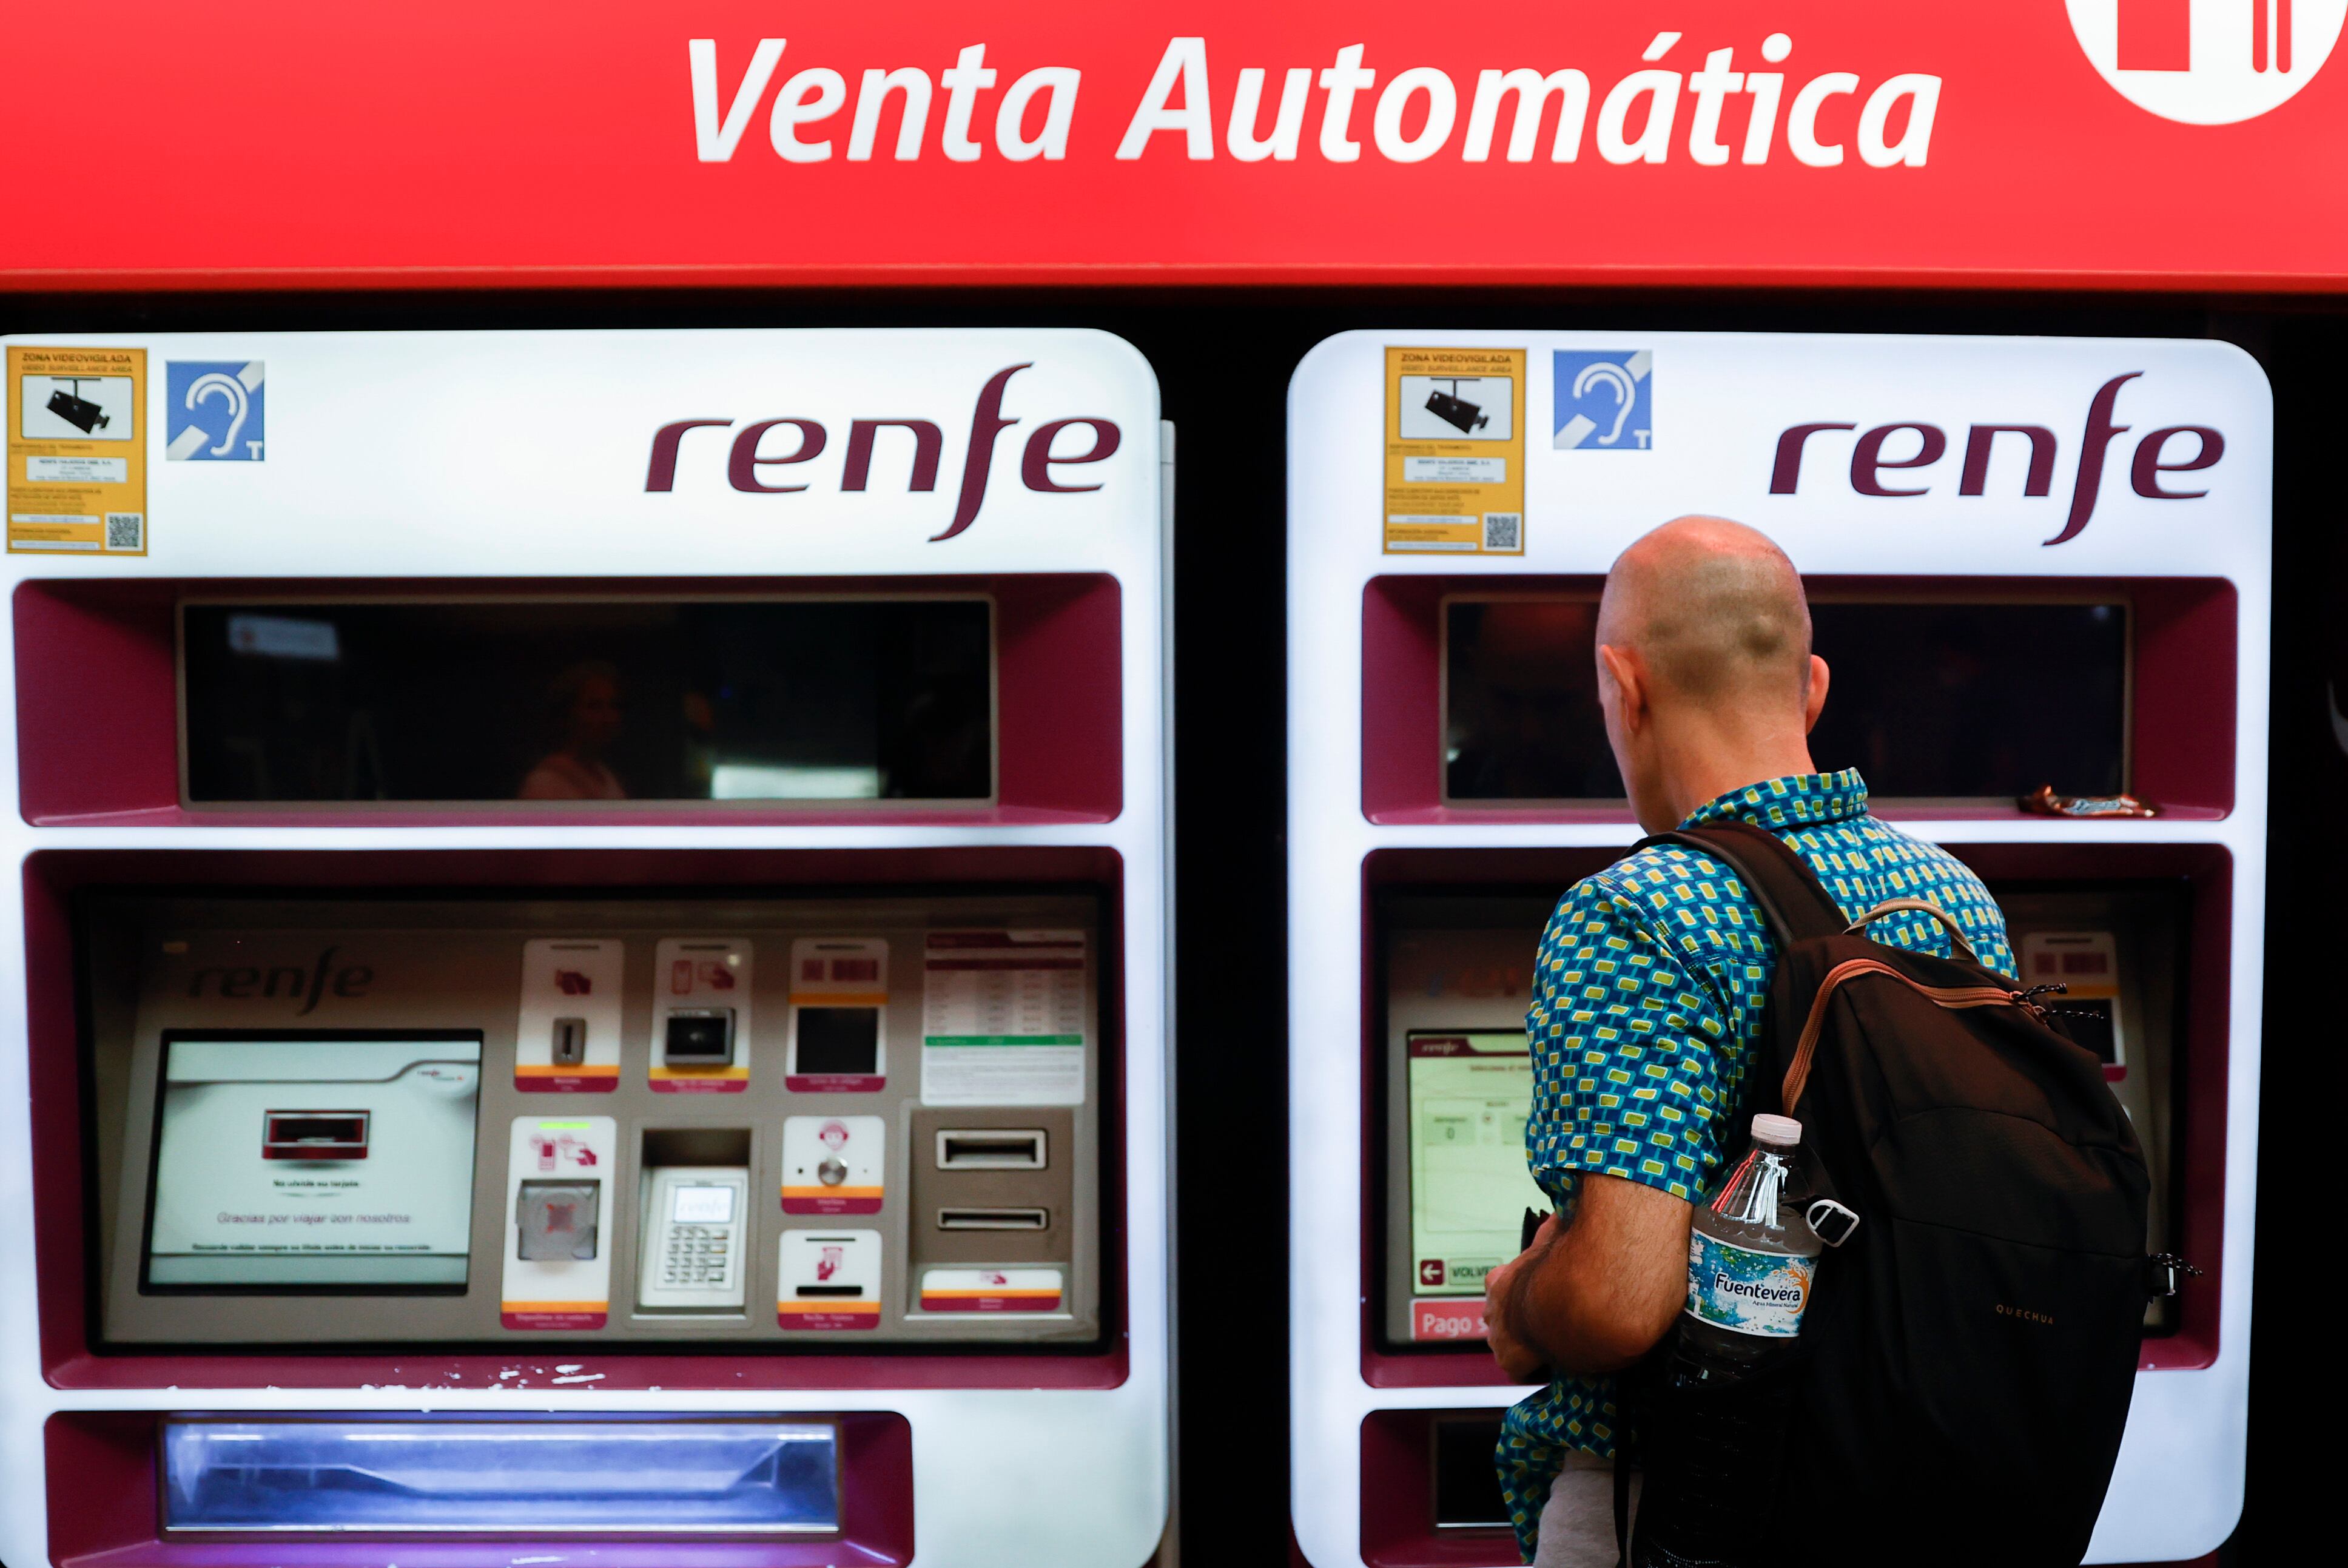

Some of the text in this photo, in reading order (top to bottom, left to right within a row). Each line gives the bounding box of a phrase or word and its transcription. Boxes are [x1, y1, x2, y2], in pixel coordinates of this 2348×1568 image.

[688, 32, 1942, 169] Venta Automática
[22, 352, 132, 363] ZONA VIDEOVIGILADA
[1401, 352, 1512, 363] ZONA VIDEOVIGILADA
[245, 440, 263, 460] T
[1633, 428, 1651, 449] T
[644, 362, 1122, 543] renfe
[1768, 371, 2226, 547] renfe
[187, 944, 374, 1018] renfe
[217, 1212, 265, 1224] Gracias
[267, 1214, 289, 1226] por
[292, 1213, 326, 1225] viajar
[355, 1213, 411, 1224] nosotros
[1715, 1273, 1801, 1302] Fuentevera
[1422, 1313, 1490, 1338] Pago s
[1996, 1304, 2054, 1325] QUECHUA
